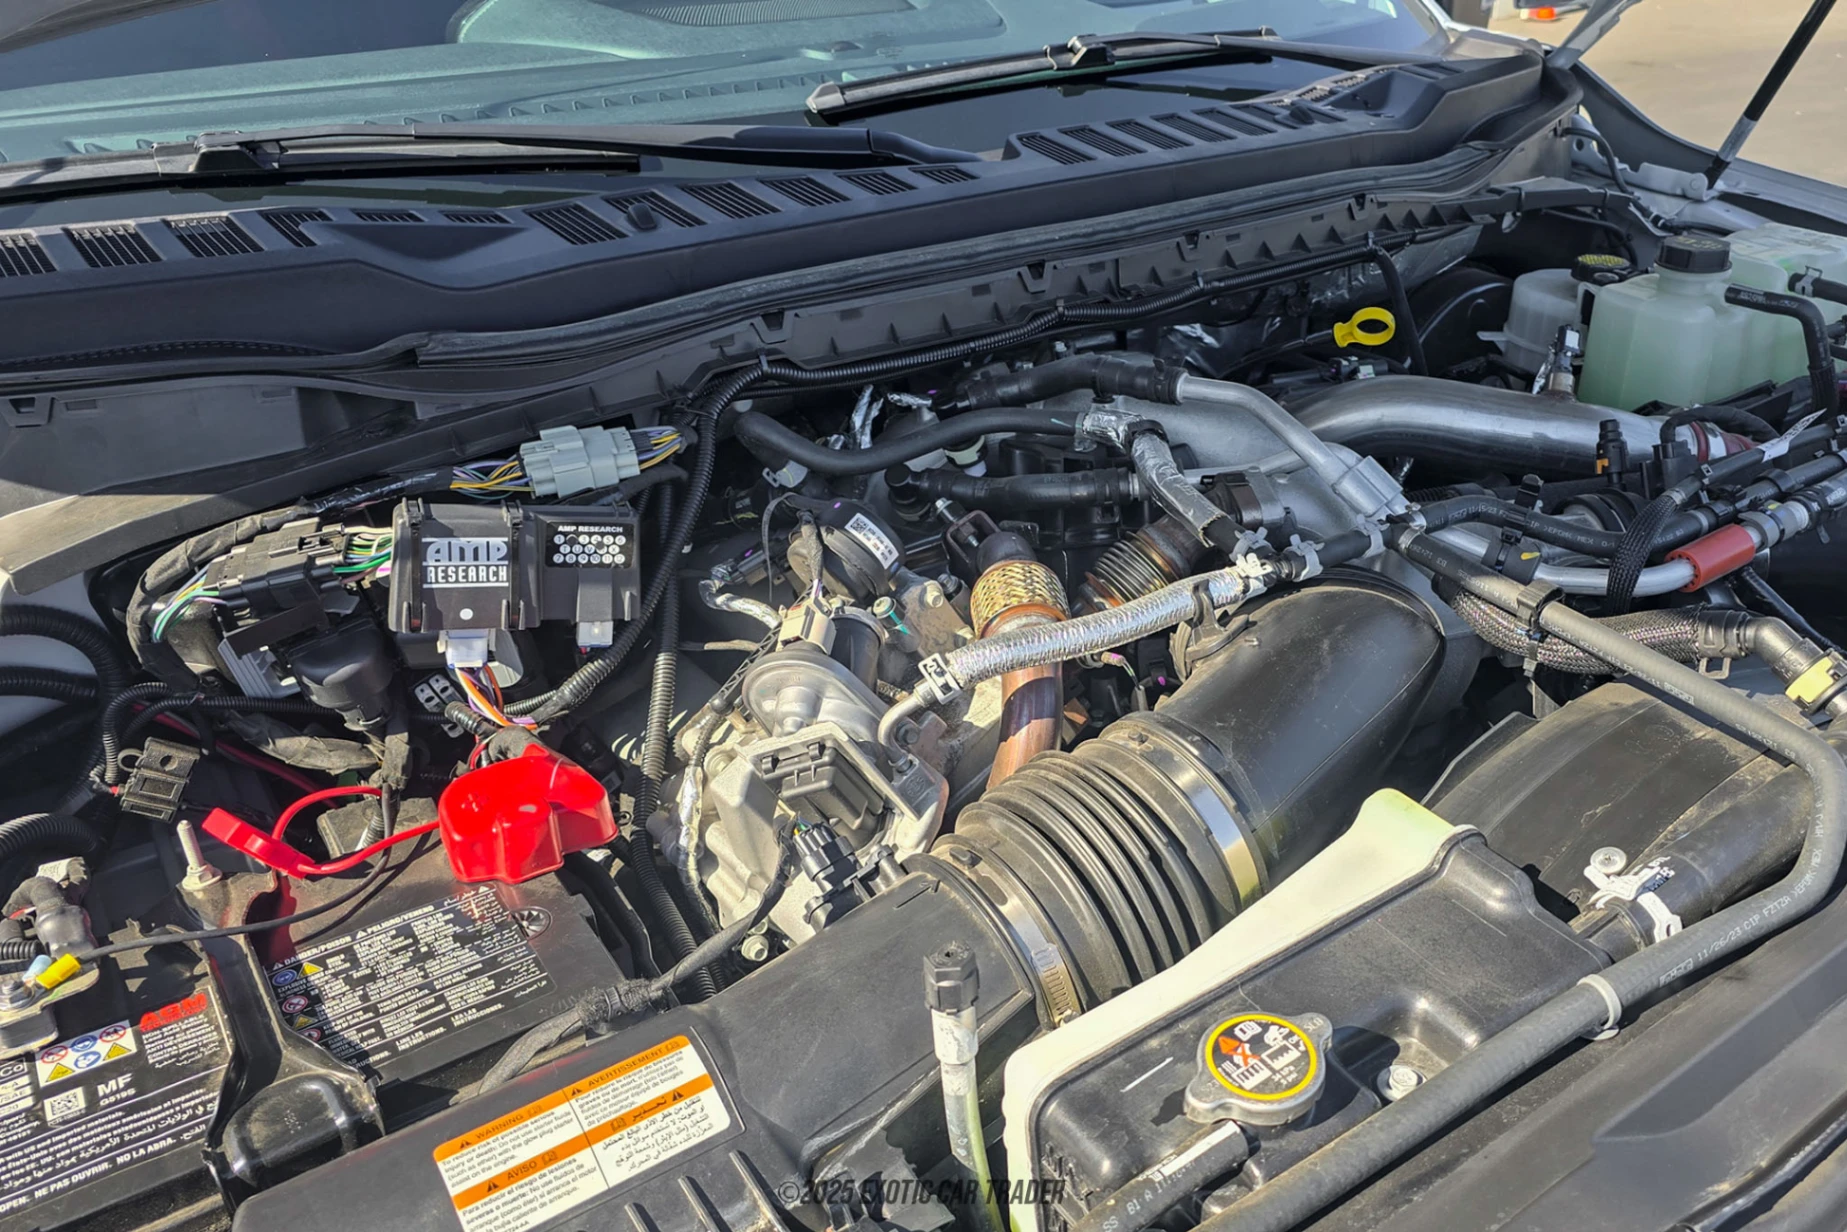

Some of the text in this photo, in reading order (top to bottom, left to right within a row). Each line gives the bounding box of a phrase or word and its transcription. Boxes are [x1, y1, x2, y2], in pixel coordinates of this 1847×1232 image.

[578, 525, 623, 533] RESEARCH
[426, 540, 508, 562] AMP
[427, 565, 508, 583] RESEARCH
[1698, 927, 1743, 962] 11/26/23
[1744, 914, 1761, 931] CIP
[1812, 848, 1822, 868] MEX
[284, 936, 351, 964] DANGER/POISON
[367, 905, 433, 933] PELIGRO/VENENO
[139, 992, 207, 1023] AGM
[454, 1004, 504, 1025] INSTRUCCIONES.
[398, 1028, 446, 1049] INSTRUCTIONS.
[588, 1048, 662, 1086] AVERTISSEMENT
[621, 1077, 637, 1088] mort,
[98, 1073, 133, 1096] MF
[37, 1138, 51, 1148] and
[88, 1110, 124, 1127] materials.
[453, 1148, 475, 1161] reduce
[478, 1141, 490, 1149] risk
[501, 1123, 528, 1139] possible
[531, 1111, 554, 1125] serious
[476, 1113, 524, 1139] WARNING
[521, 1129, 532, 1137] use
[534, 1119, 553, 1131] starter
[555, 1110, 571, 1121] fluids
[448, 1168, 466, 1180] (such
[477, 1154, 496, 1167] ether)
[498, 1147, 511, 1156] with
[524, 1135, 538, 1145] glow
[539, 1127, 553, 1138] plug
[554, 1117, 573, 1129] starter
[34, 1186, 49, 1198] NE
[51, 1178, 70, 1191] PAS
[71, 1161, 112, 1182] OUVRIR.
[116, 1153, 131, 1164] NO
[132, 1147, 145, 1158] LA
[147, 1136, 175, 1153] ABRA.
[451, 1175, 470, 1187] assist
[494, 1153, 517, 1168] engine.
[507, 1161, 537, 1179] AVISO
[463, 1205, 480, 1217] Para
[481, 1192, 506, 1207] reducir
[516, 1177, 538, 1192] riesgo
[549, 1158, 576, 1174] lesiones
[467, 1208, 494, 1224] severas
[502, 1191, 529, 1207] muerte:
[542, 1179, 553, 1188] use
[554, 1167, 575, 1181] fluidos
[501, 1203, 522, 1218] (como
[547, 1179, 571, 1194] arranca
[579, 1166, 597, 1178] motor
